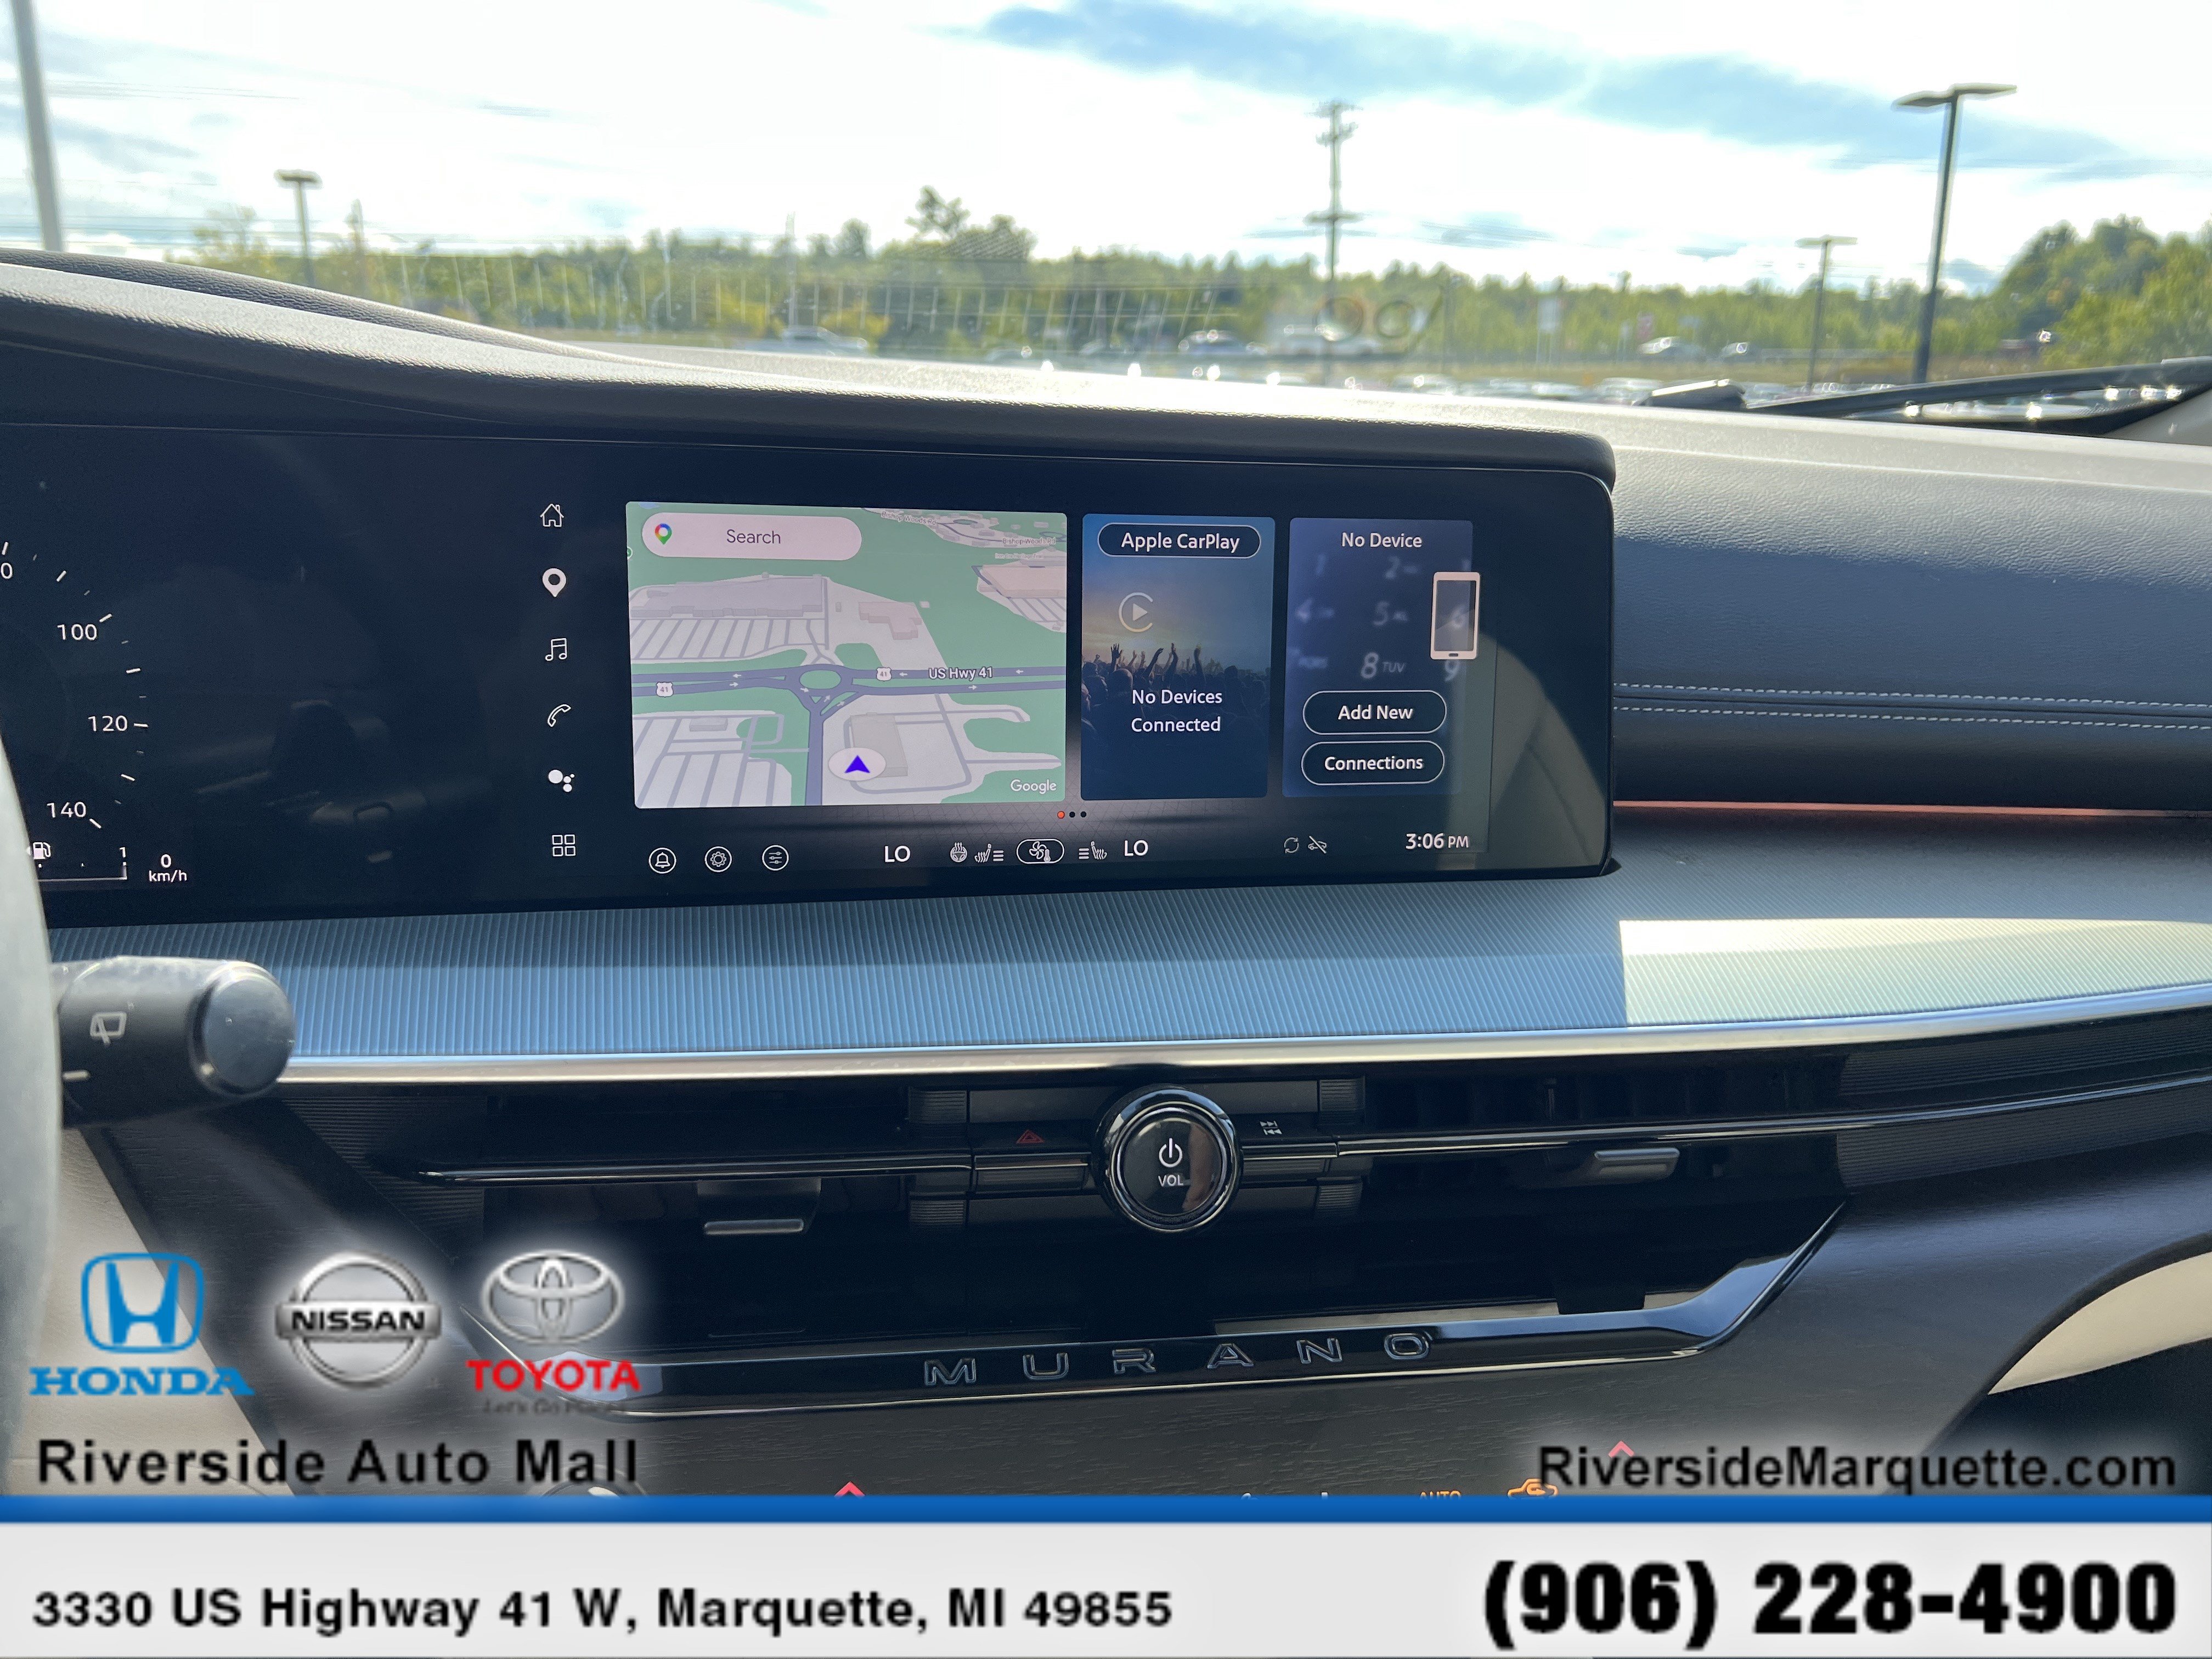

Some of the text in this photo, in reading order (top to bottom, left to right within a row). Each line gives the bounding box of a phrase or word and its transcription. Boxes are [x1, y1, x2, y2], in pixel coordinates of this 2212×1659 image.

[726, 528, 781, 545] Search
[1120, 532, 1240, 554] Apple CarPlay
[1341, 532, 1423, 548] No Device
[57, 624, 98, 641] 100
[1361, 652, 1406, 679] 8 TUV
[928, 666, 994, 682] US Hwy 41
[660, 686, 669, 694] 41
[1132, 689, 1223, 704] No Devices
[1337, 704, 1414, 720] Add New
[88, 715, 128, 732] 120
[1131, 716, 1221, 733] Connected
[1324, 755, 1424, 771] Connections
[1010, 778, 1057, 794] Google
[47, 802, 87, 819] 140
[1124, 840, 1148, 857] LO
[1405, 833, 1470, 850] 3:06 PM
[119, 847, 127, 859] 1
[160, 854, 172, 868] 0
[884, 845, 911, 863] LO
[148, 870, 188, 883] km/h
[1158, 1174, 1184, 1187] VOL
[924, 1332, 1433, 1386] MURANO
